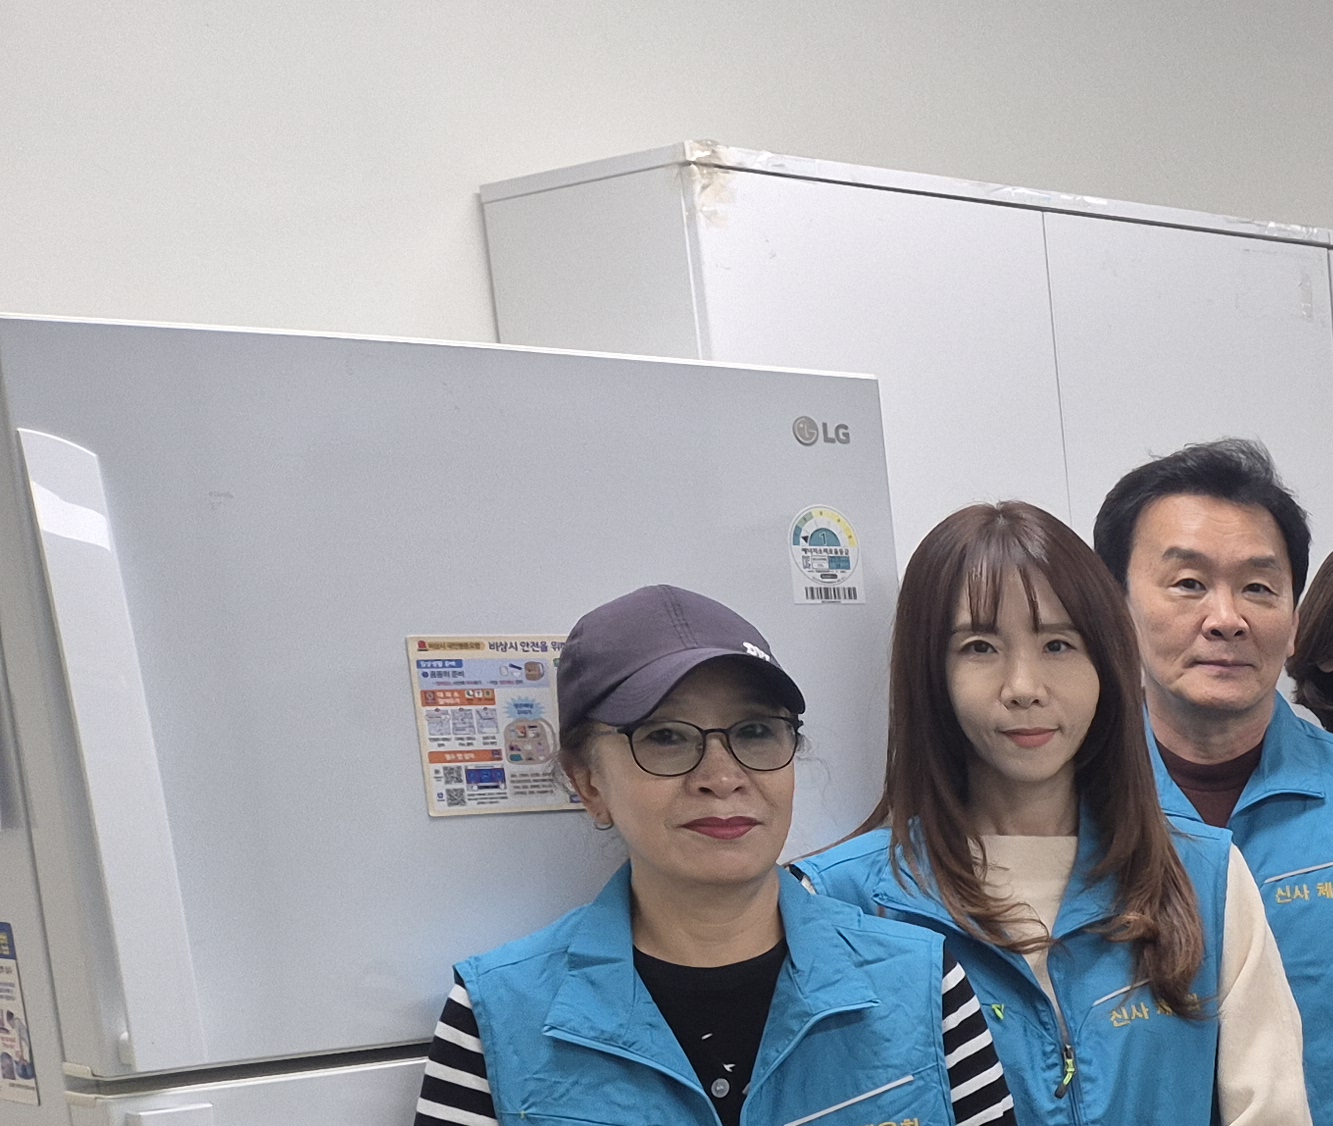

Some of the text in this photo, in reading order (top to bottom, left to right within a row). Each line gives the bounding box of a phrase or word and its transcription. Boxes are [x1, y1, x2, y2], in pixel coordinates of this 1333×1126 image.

[822, 421, 851, 445] LG
[1274, 884, 1310, 904] 신사
[1109, 1003, 1150, 1028] 신사
